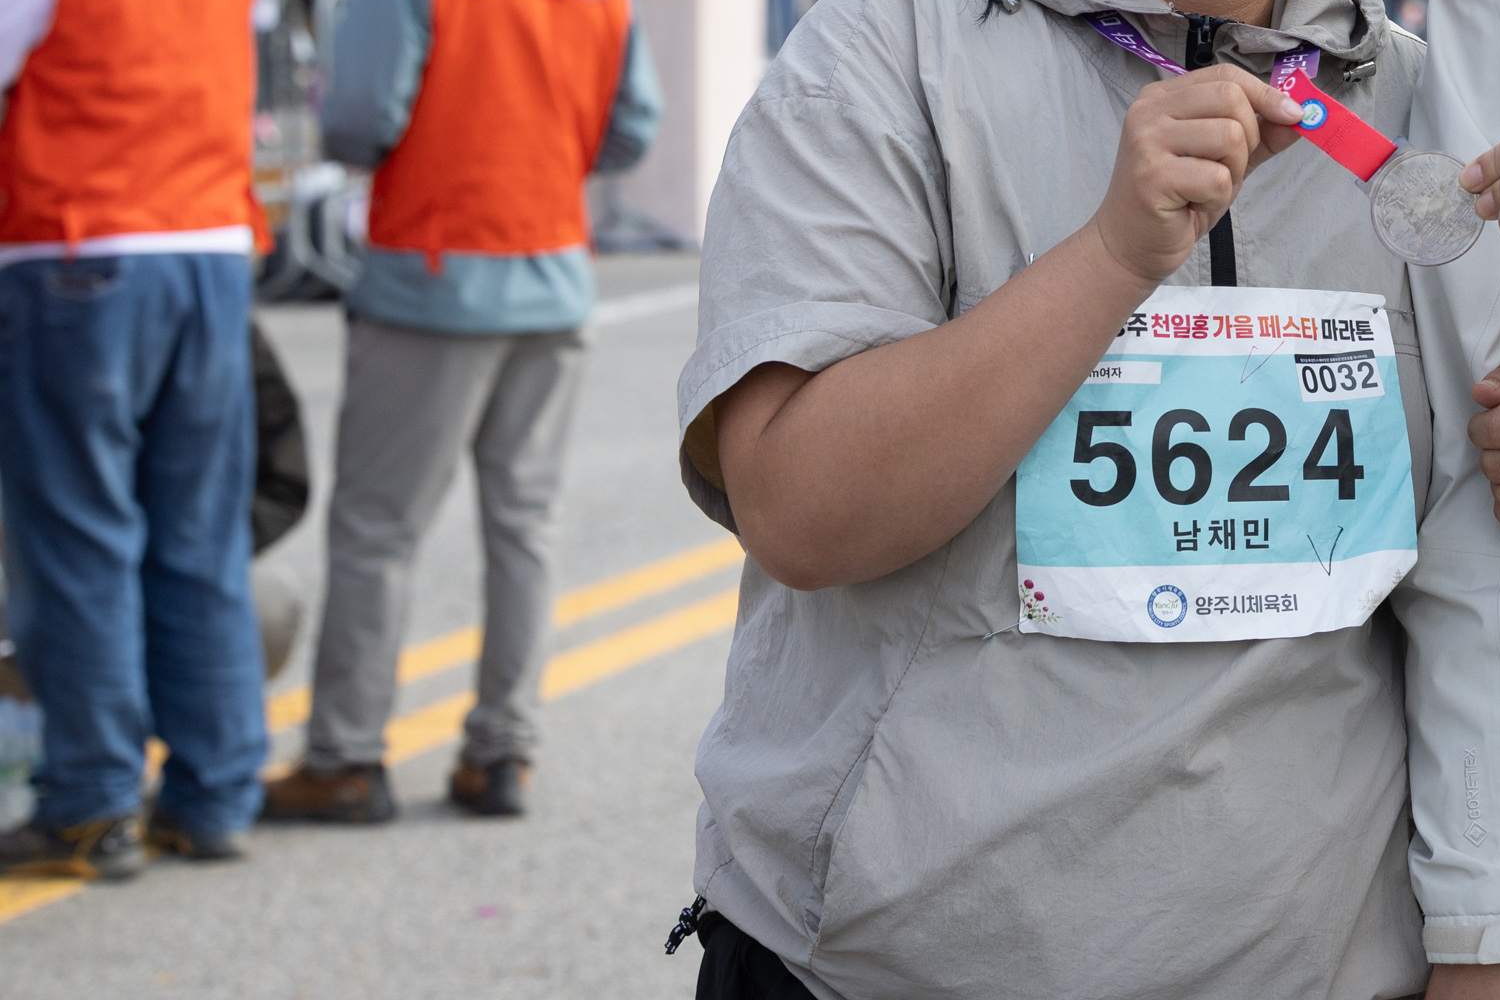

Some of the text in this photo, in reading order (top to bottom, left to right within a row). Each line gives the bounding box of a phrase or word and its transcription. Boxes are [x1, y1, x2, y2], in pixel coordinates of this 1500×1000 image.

[1116, 313, 1375, 342] 주 천일홍 가을 페스타 마라톤
[1301, 361, 1379, 394] 0032
[1069, 407, 1365, 507] 5624
[1172, 518, 1270, 552] 남채민
[1194, 594, 1299, 617] 양주시체육회
[1464, 747, 1482, 820] GORE-TEX
